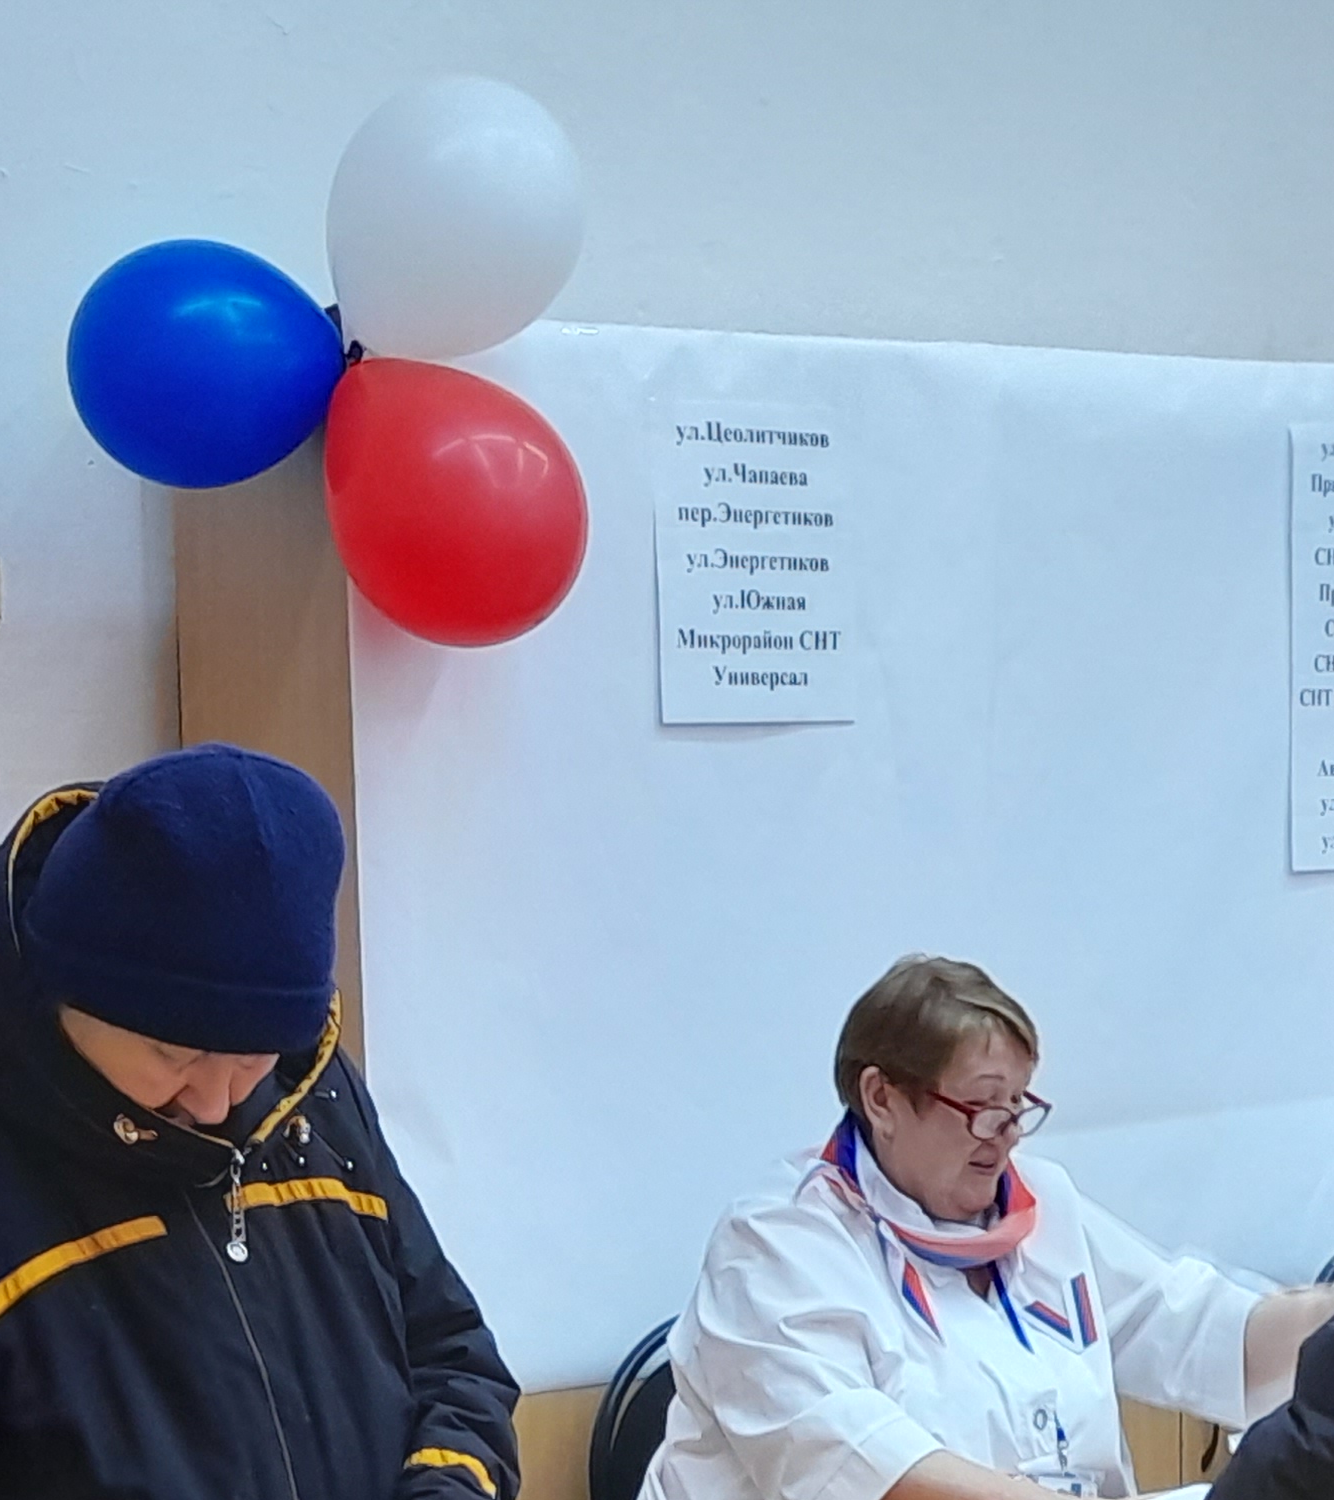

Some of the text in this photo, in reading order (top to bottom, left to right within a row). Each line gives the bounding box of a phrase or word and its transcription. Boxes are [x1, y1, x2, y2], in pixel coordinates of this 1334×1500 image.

[675, 421, 830, 448] ул.Цеолитчиков
[703, 462, 808, 487] ул.Чапаева
[677, 502, 834, 530] пер.Энергетиков
[685, 548, 830, 576] ул.Энергетиков
[712, 589, 807, 615] ул.Южная
[676, 628, 842, 654] Микрорайон СНТ
[712, 665, 809, 691] Универсал
[1299, 688, 1333, 708] СНТ
